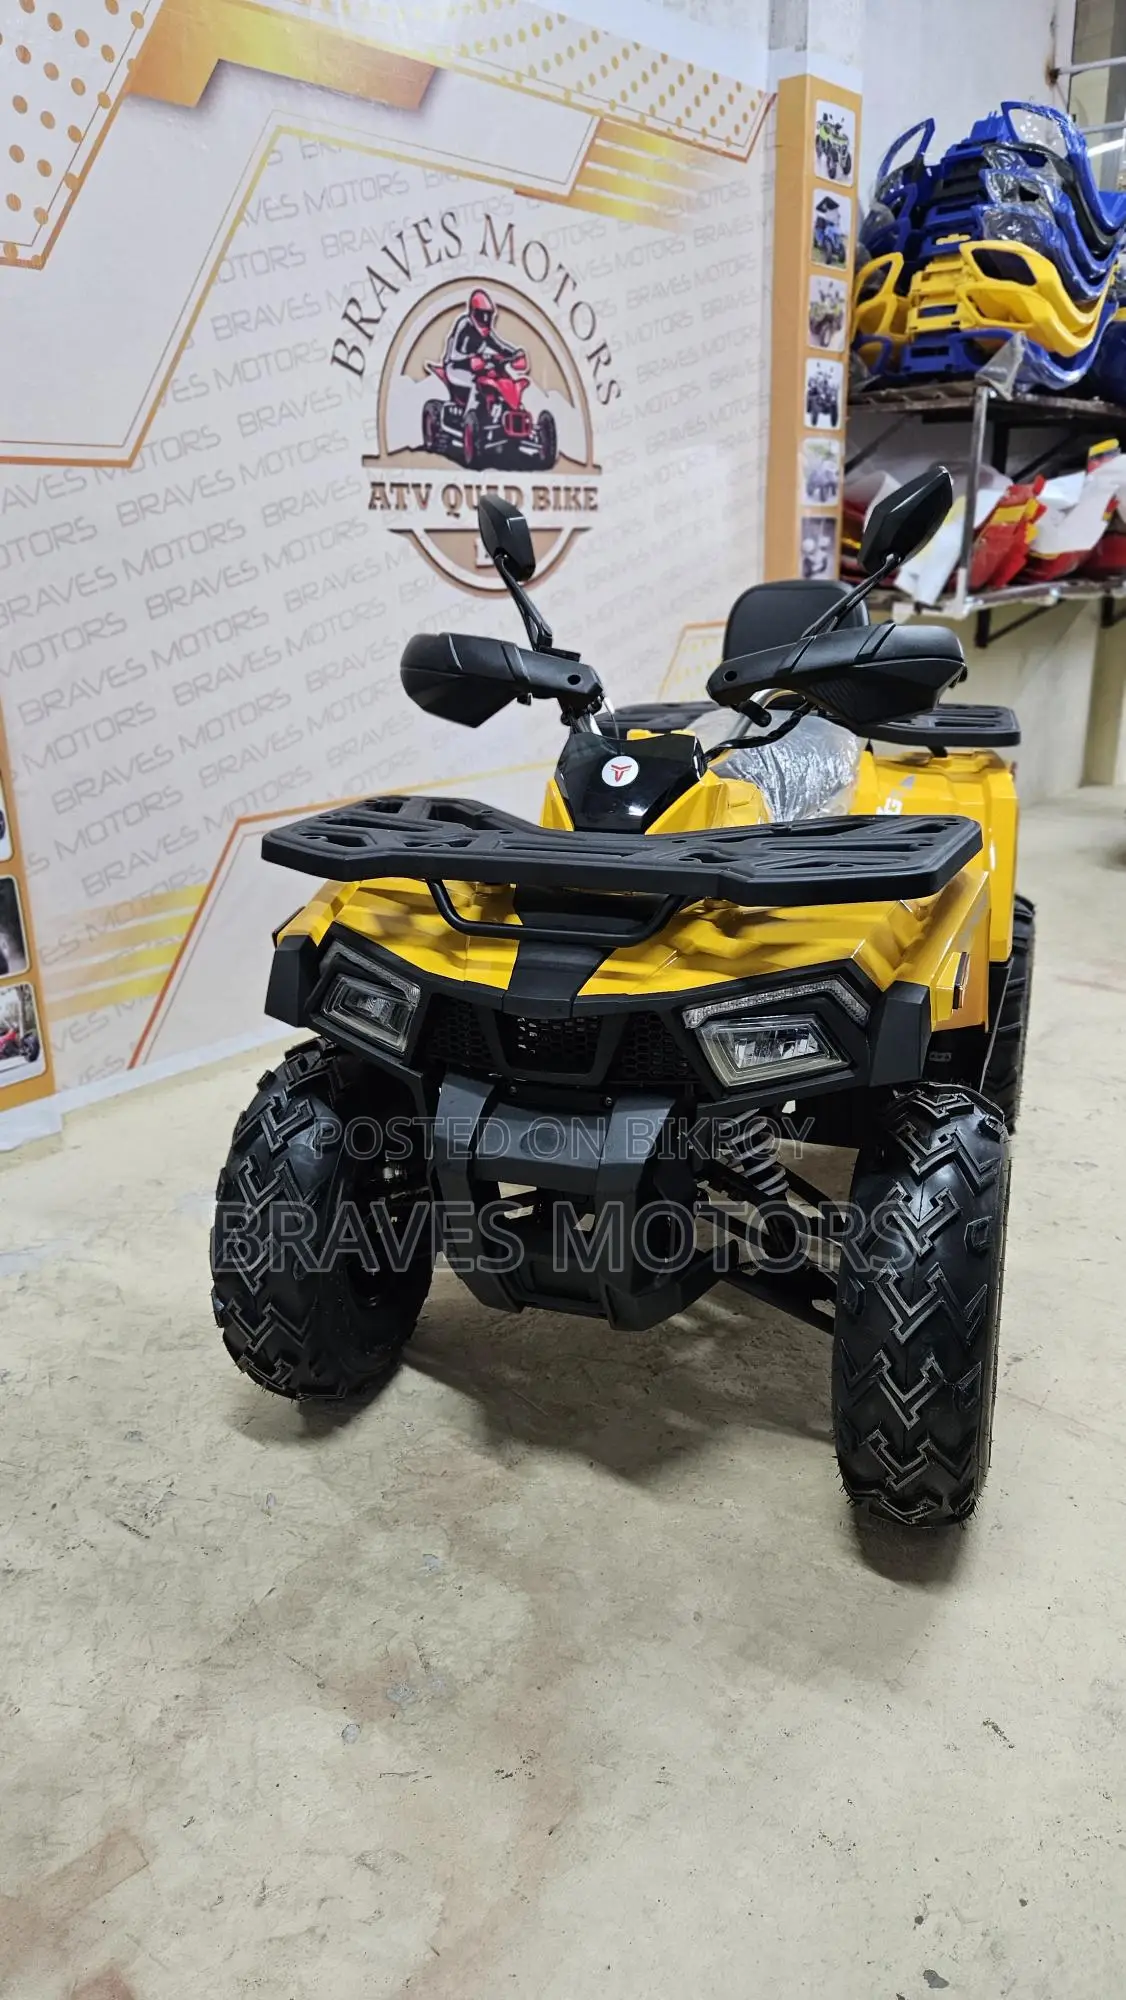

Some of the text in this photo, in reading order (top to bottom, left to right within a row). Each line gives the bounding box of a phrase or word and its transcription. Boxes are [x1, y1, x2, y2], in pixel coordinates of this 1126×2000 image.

[303, 171, 410, 215] MOTORS
[210, 291, 322, 342] BRAVES
[329, 211, 622, 406] BRAVES MOTORS
[212, 338, 328, 393] MOTORS
[237, 385, 343, 439] BRAVES
[116, 469, 236, 527] BRAVES
[238, 430, 349, 485] MOTORS
[121, 517, 247, 582] MOTORS
[261, 474, 363, 528] BRAVES
[368, 482, 432, 510] ATV
[441, 483, 524, 518] QUD
[531, 486, 598, 511] BIKE
[145, 558, 260, 621] BRAVES
[262, 515, 368, 573] MOTORS
[17, 557, 381, 726] BRAVES MOTORS BRAVES
[21, 700, 157, 775] MOTORS
[172, 644, 282, 707] BRAVES
[284, 596, 386, 657] MOTORS
[50, 743, 174, 815] BRAVES
[178, 687, 292, 754] MOTORS
[305, 634, 399, 694] BRAVES
[53, 671, 402, 860] MOTORS BRAVES MOTORS
[81, 825, 199, 898] BRAVES
[202, 765, 312, 834] MOTORS
[326, 709, 415, 769] BRAVES
[84, 862, 208, 942] MOTORS
